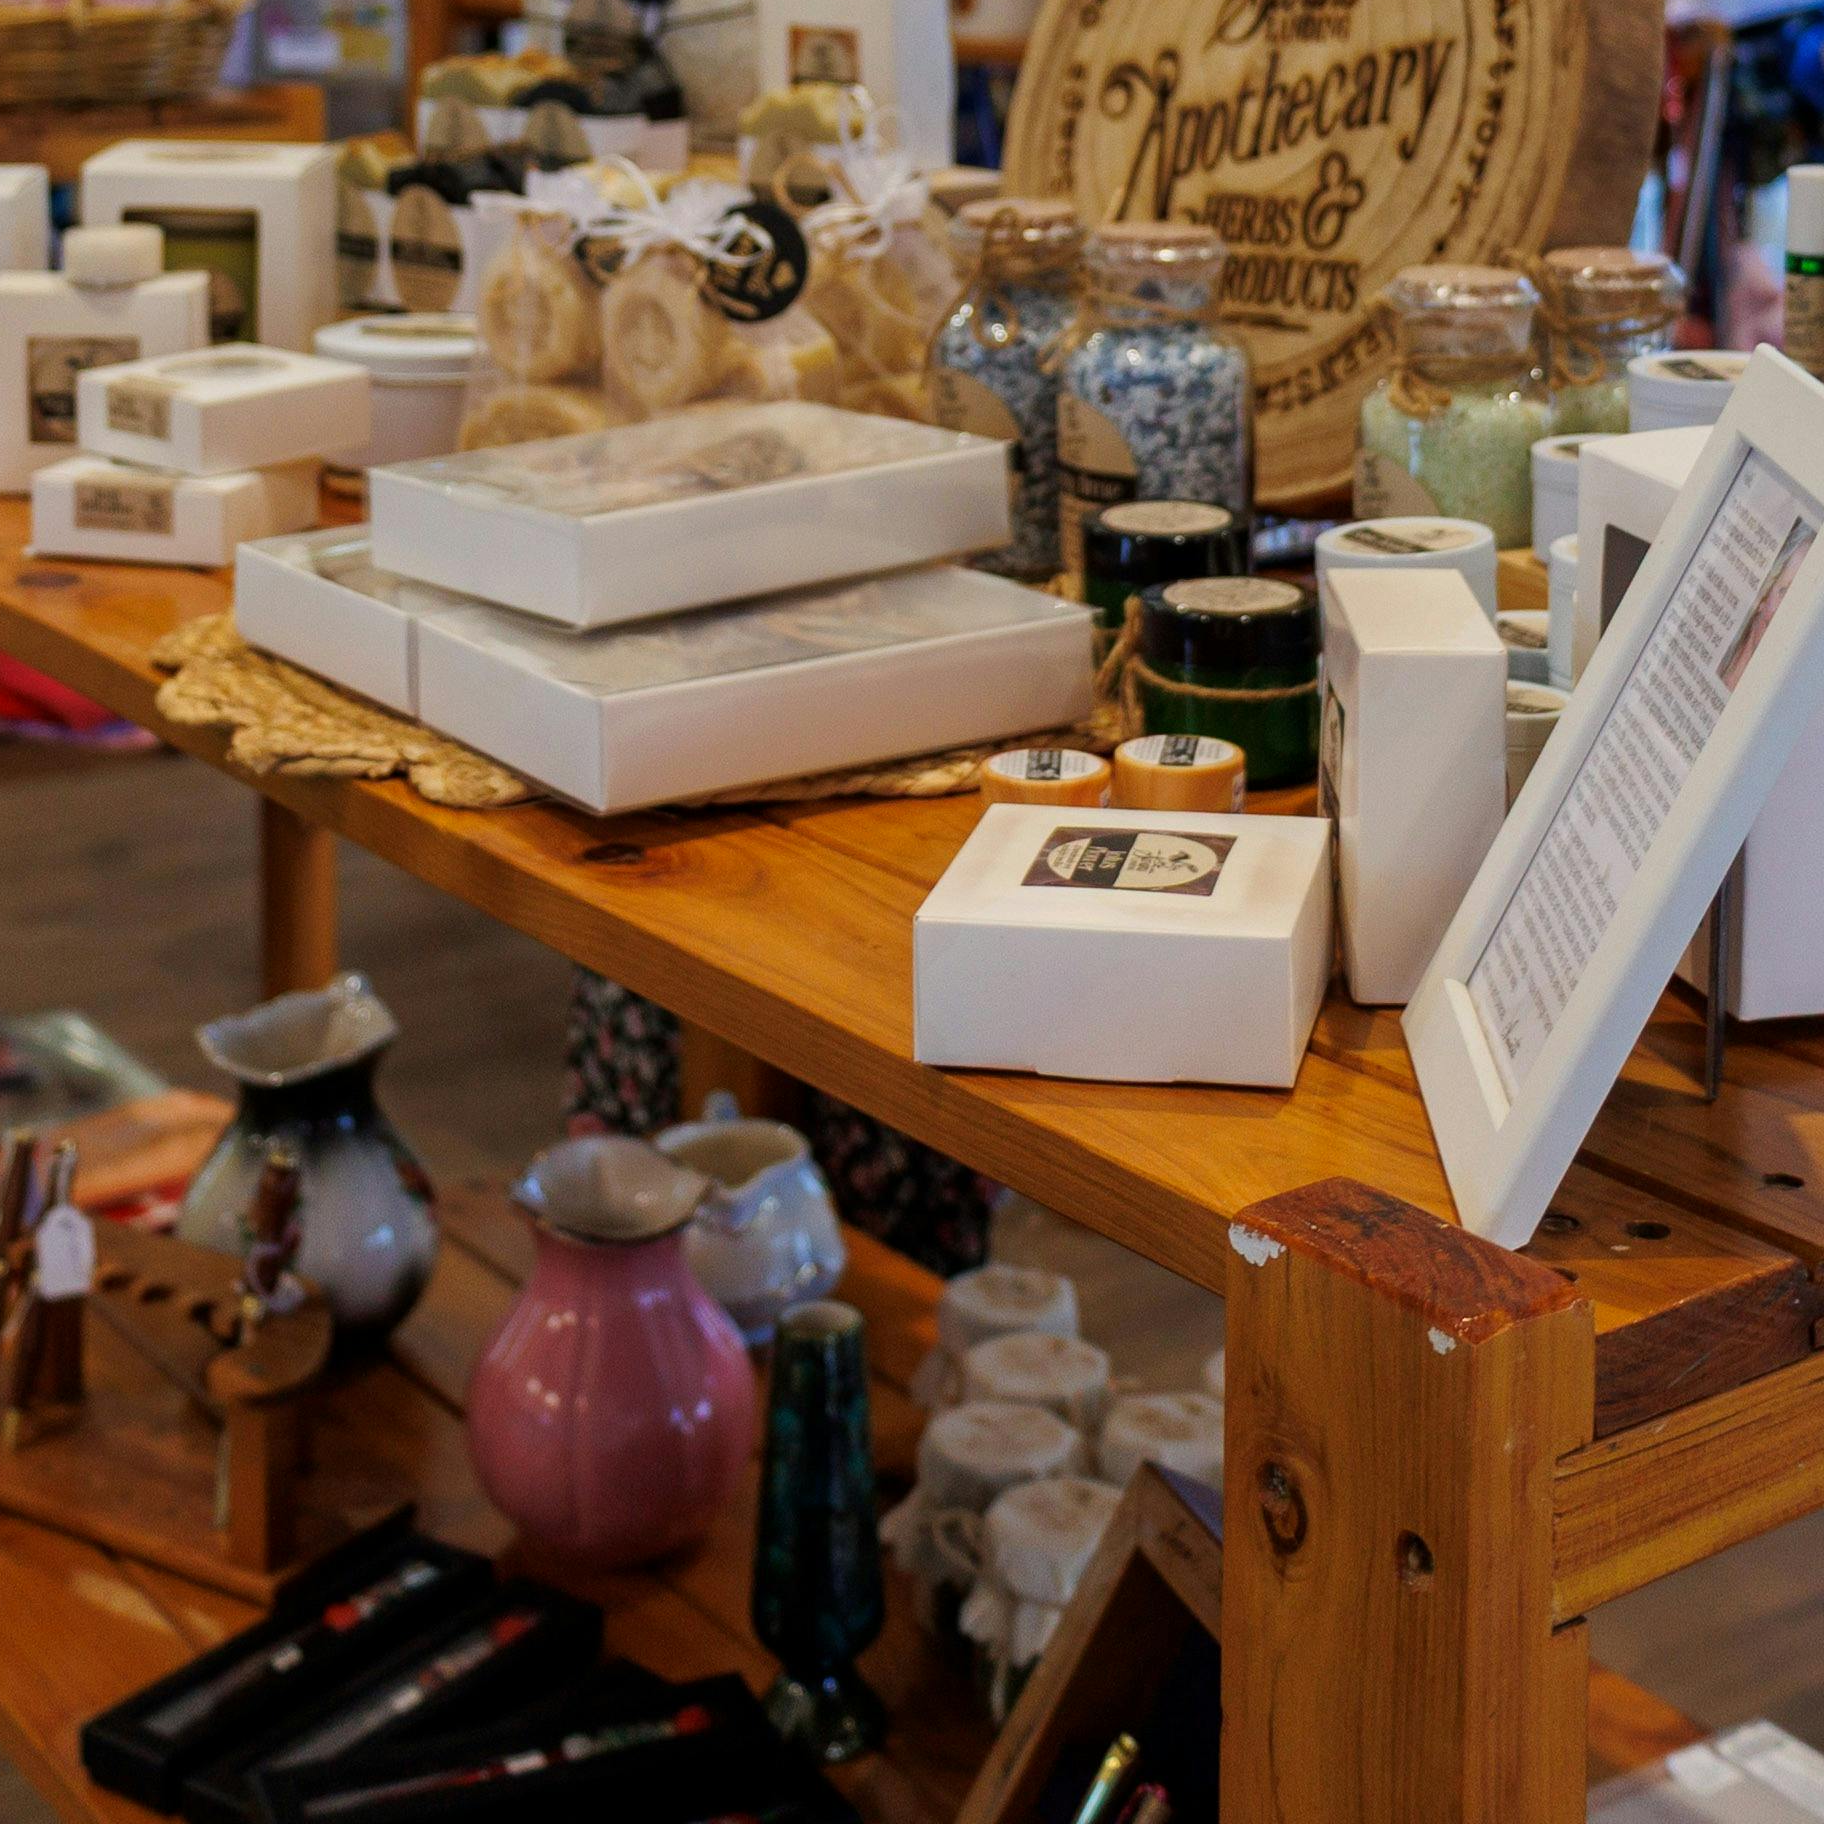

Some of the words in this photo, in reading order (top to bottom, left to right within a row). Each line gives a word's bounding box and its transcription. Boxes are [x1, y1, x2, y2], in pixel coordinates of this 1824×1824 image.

[1099, 36, 1456, 222] Apothecary
[1201, 190, 1298, 246] HERBS
[1303, 150, 1366, 251] &
[1219, 253, 1361, 313] RODUCTS
